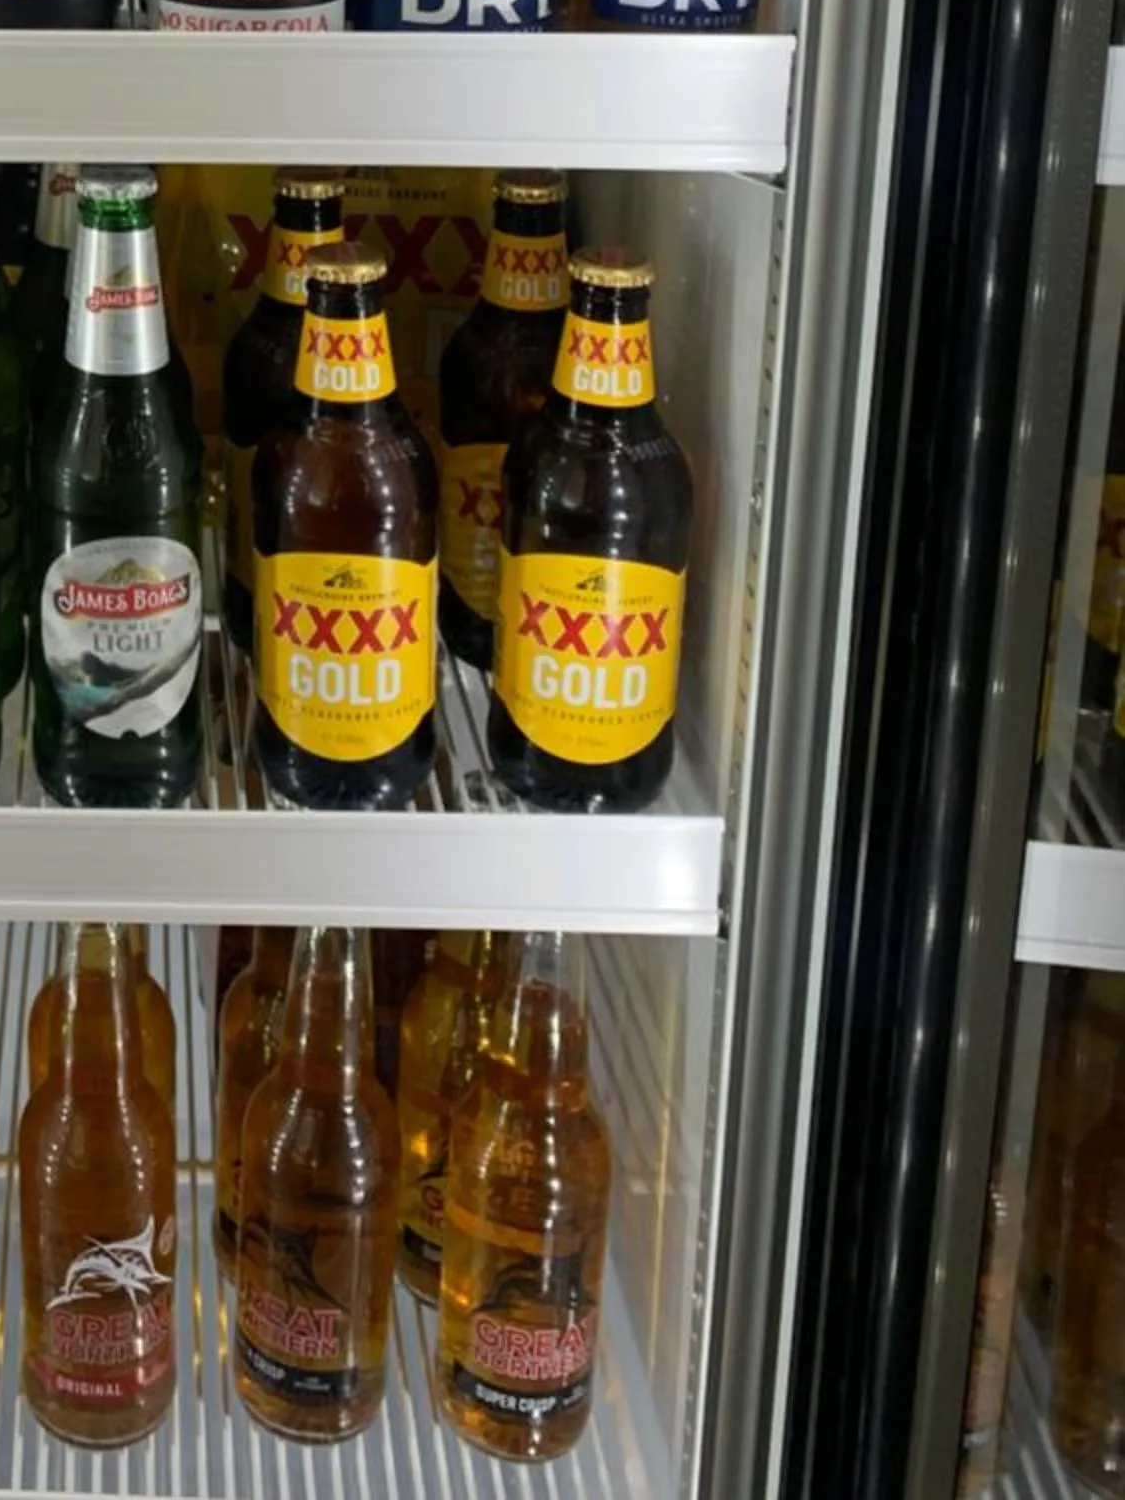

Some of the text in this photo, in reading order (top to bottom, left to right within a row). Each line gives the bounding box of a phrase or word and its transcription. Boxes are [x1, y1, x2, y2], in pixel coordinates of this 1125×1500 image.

[493, 243, 565, 274] XXXX
[499, 277, 561, 300] GOLD
[306, 327, 385, 362] XXXX
[567, 328, 650, 366] XXXX
[313, 364, 380, 391] GOLD
[573, 367, 642, 396] GOLD
[58, 584, 128, 613] JAMES
[272, 590, 420, 656] XXXX
[518, 590, 669, 659] XXXX
[93, 631, 164, 653] LIGHT
[289, 653, 401, 708] GOLD
[531, 653, 648, 710] GOLD
[56, 1375, 124, 1397] ORIGINAL
